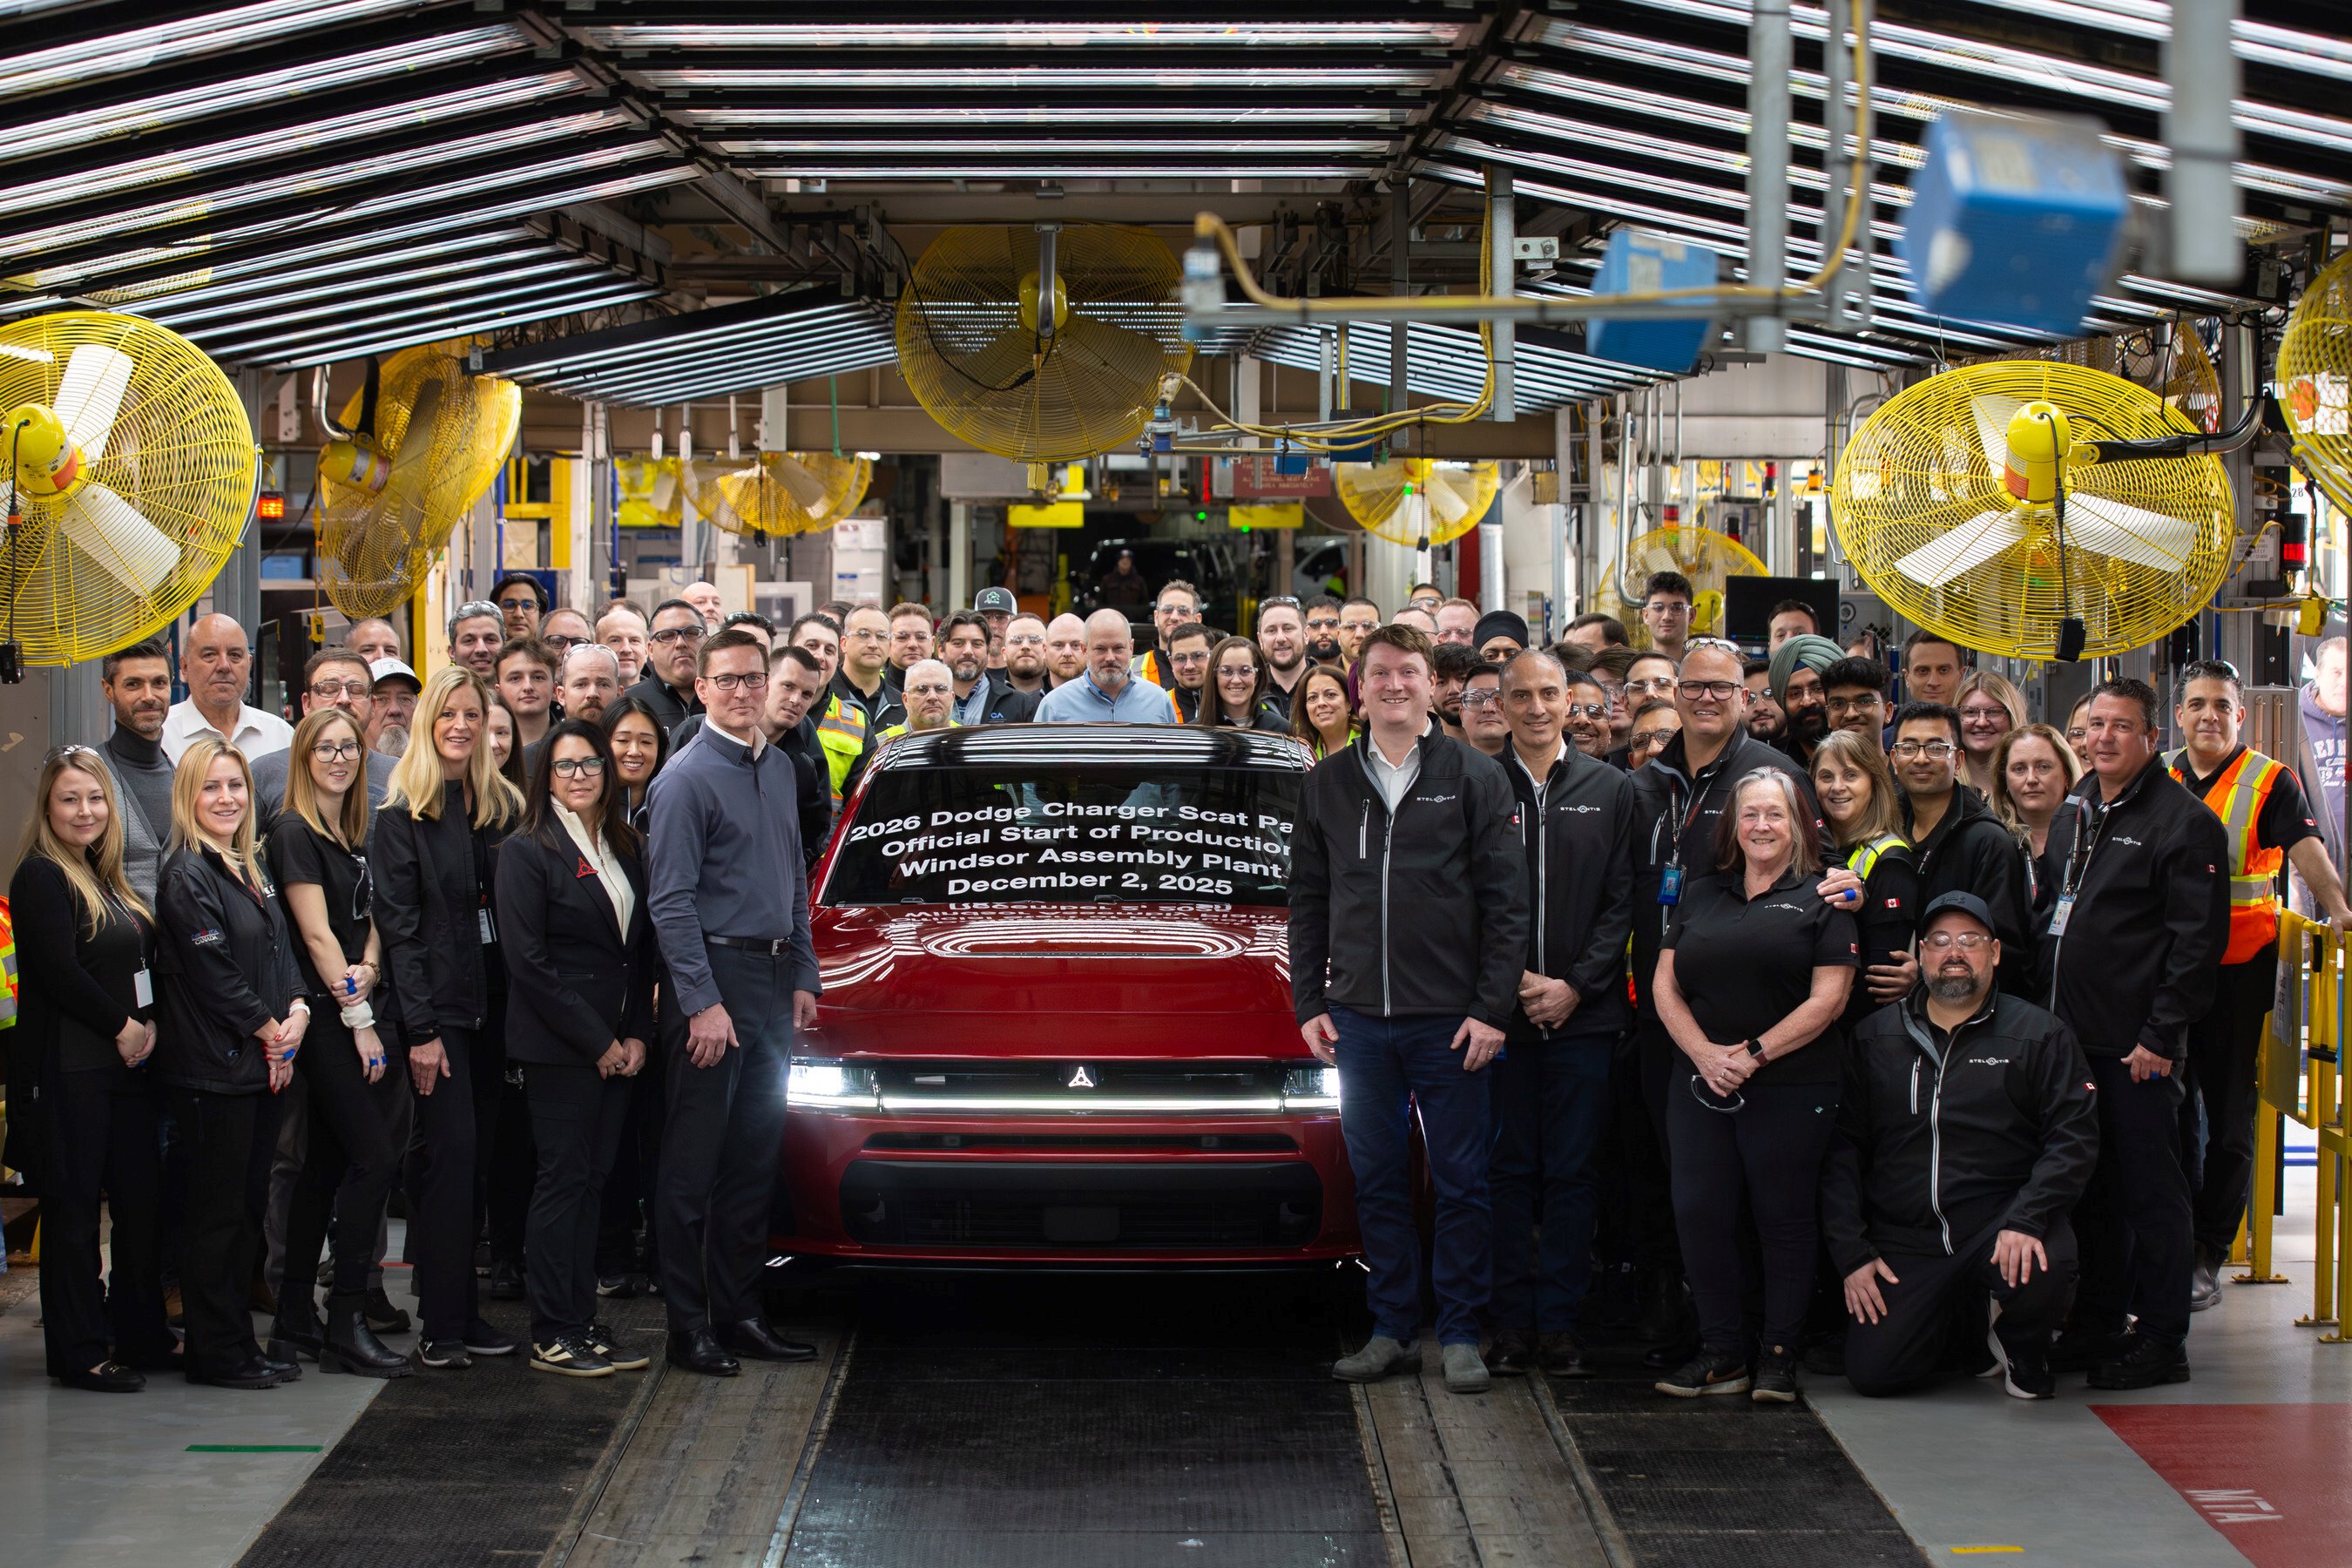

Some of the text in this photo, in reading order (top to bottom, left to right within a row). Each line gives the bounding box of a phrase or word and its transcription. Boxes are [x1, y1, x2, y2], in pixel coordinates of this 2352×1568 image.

[849, 815, 921, 842] 2026
[930, 806, 1032, 827] Dodge
[1042, 802, 1170, 820] Charger
[1178, 806, 1248, 826] Scat
[1560, 805, 1601, 814] STELLANTIS
[882, 828, 990, 856] Official
[1000, 825, 1078, 841] Start
[1089, 825, 1120, 839] of
[899, 848, 1283, 879] Windsor Assembly Plant
[948, 872, 1233, 896] December 2, 2025
[1970, 1057, 2010, 1065] STELLANTIS
